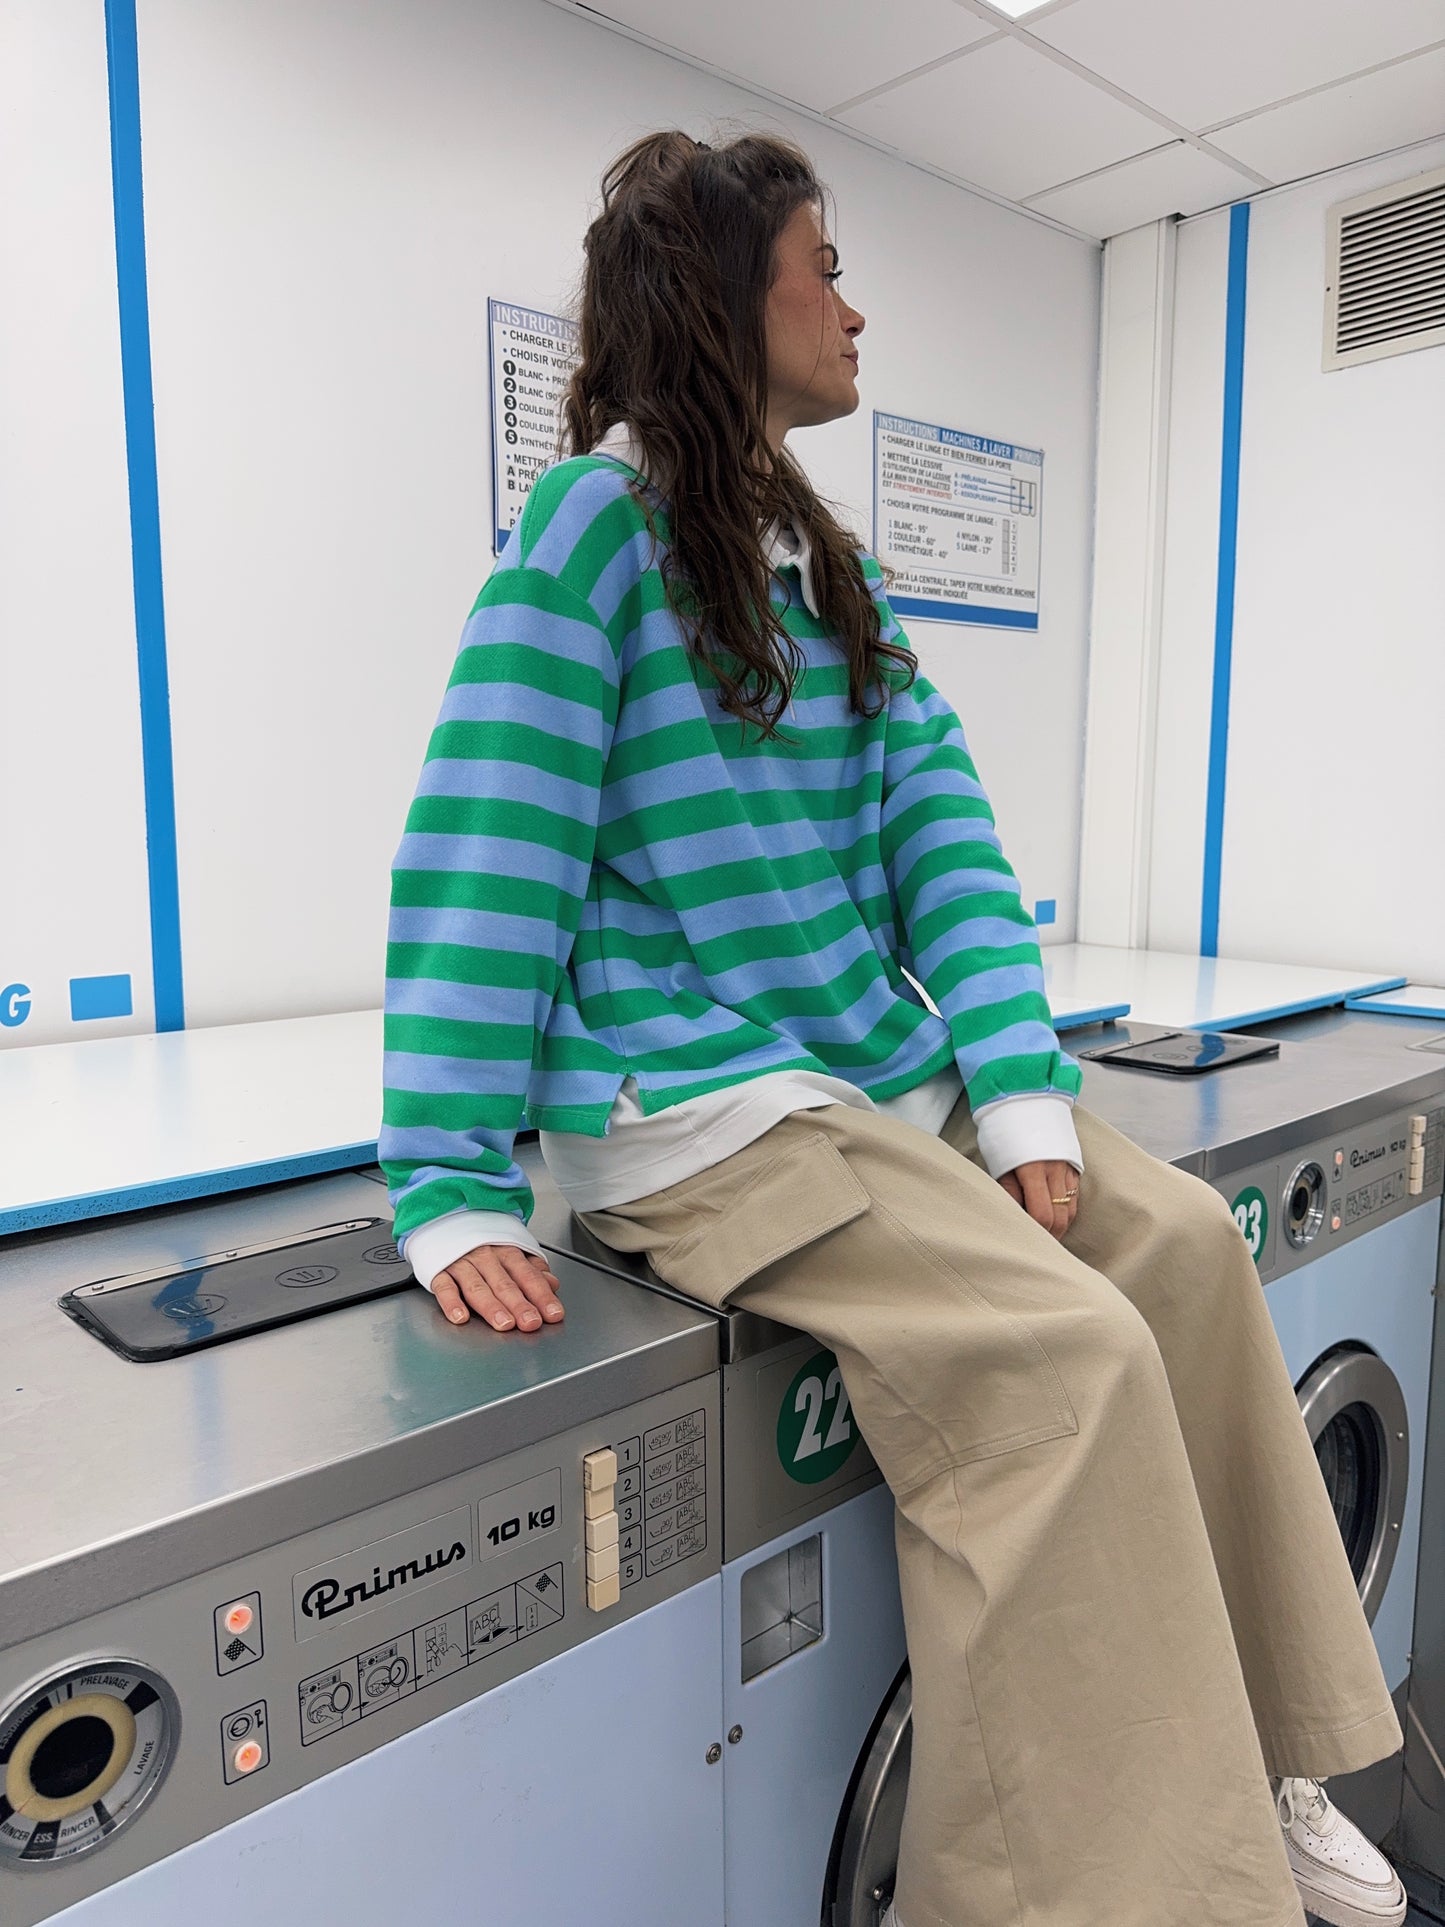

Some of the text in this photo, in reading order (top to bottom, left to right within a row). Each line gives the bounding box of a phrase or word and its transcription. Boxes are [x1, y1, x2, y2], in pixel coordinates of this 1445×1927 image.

[495, 304, 579, 339] INSTRUCTI
[510, 329, 554, 350] CHARGER
[556, 342, 567, 353] LE
[510, 347, 549, 366] CHOISIR
[518, 367, 543, 381] BLANC
[518, 385, 543, 398] BLANC
[518, 402, 554, 417] COULEUR
[519, 419, 555, 435] COULEUR
[880, 415, 938, 442] INSTRUCTIONS
[942, 429, 981, 452] MACHINES
[989, 441, 1011, 459] LAVER
[887, 434, 915, 449] CHARGER
[916, 441, 923, 451] LE
[924, 443, 941, 455] LINGE
[943, 447, 950, 456] ET
[951, 449, 965, 460] BIEN
[966, 453, 987, 465] FERMER
[995, 460, 1012, 471] PORTE
[514, 453, 549, 470] METTRE
[887, 451, 943, 471] METTRE LA LESSIVE
[507, 465, 515, 477] A
[508, 479, 515, 490] B
[887, 498, 911, 511] CHOISIR
[912, 503, 930, 514] VOTRE
[931, 506, 965, 520] PROGRAMME
[966, 513, 973, 522] DE
[975, 514, 994, 526] LAVAGE
[888, 519, 892, 528] 1
[894, 520, 913, 532] BLANC
[888, 531, 892, 539] 2
[893, 531, 921, 543] COULEUR
[961, 532, 980, 542] NYLON
[888, 542, 892, 551] 3
[894, 542, 934, 558] SYNTHÉTIQUE
[956, 542, 960, 550] 5
[961, 542, 977, 553] LAINE
[911, 573, 918, 583] LA
[950, 579, 966, 589] TAPER
[895, 583, 912, 593] PAYER
[913, 585, 920, 594] LA
[922, 586, 942, 596] SOMME
[943, 590, 968, 600] INDIQUÉE
[1350, 1147, 1386, 1168] Primus
[793, 1366, 850, 1463] 22
[624, 1449, 630, 1461] 1
[624, 1478, 632, 1491] 2
[624, 1507, 632, 1521] 3
[624, 1536, 632, 1549] 4
[301, 1504, 556, 1620] Primus 10 kg
[625, 1565, 634, 1578] 5
[473, 1607, 498, 1635] ABC
[80, 1674, 130, 1690] PRELAVAGE
[133, 1740, 155, 1775] LAVAGE
[1, 1822, 31, 1841] RINCER
[60, 1816, 96, 1838] RINCER
